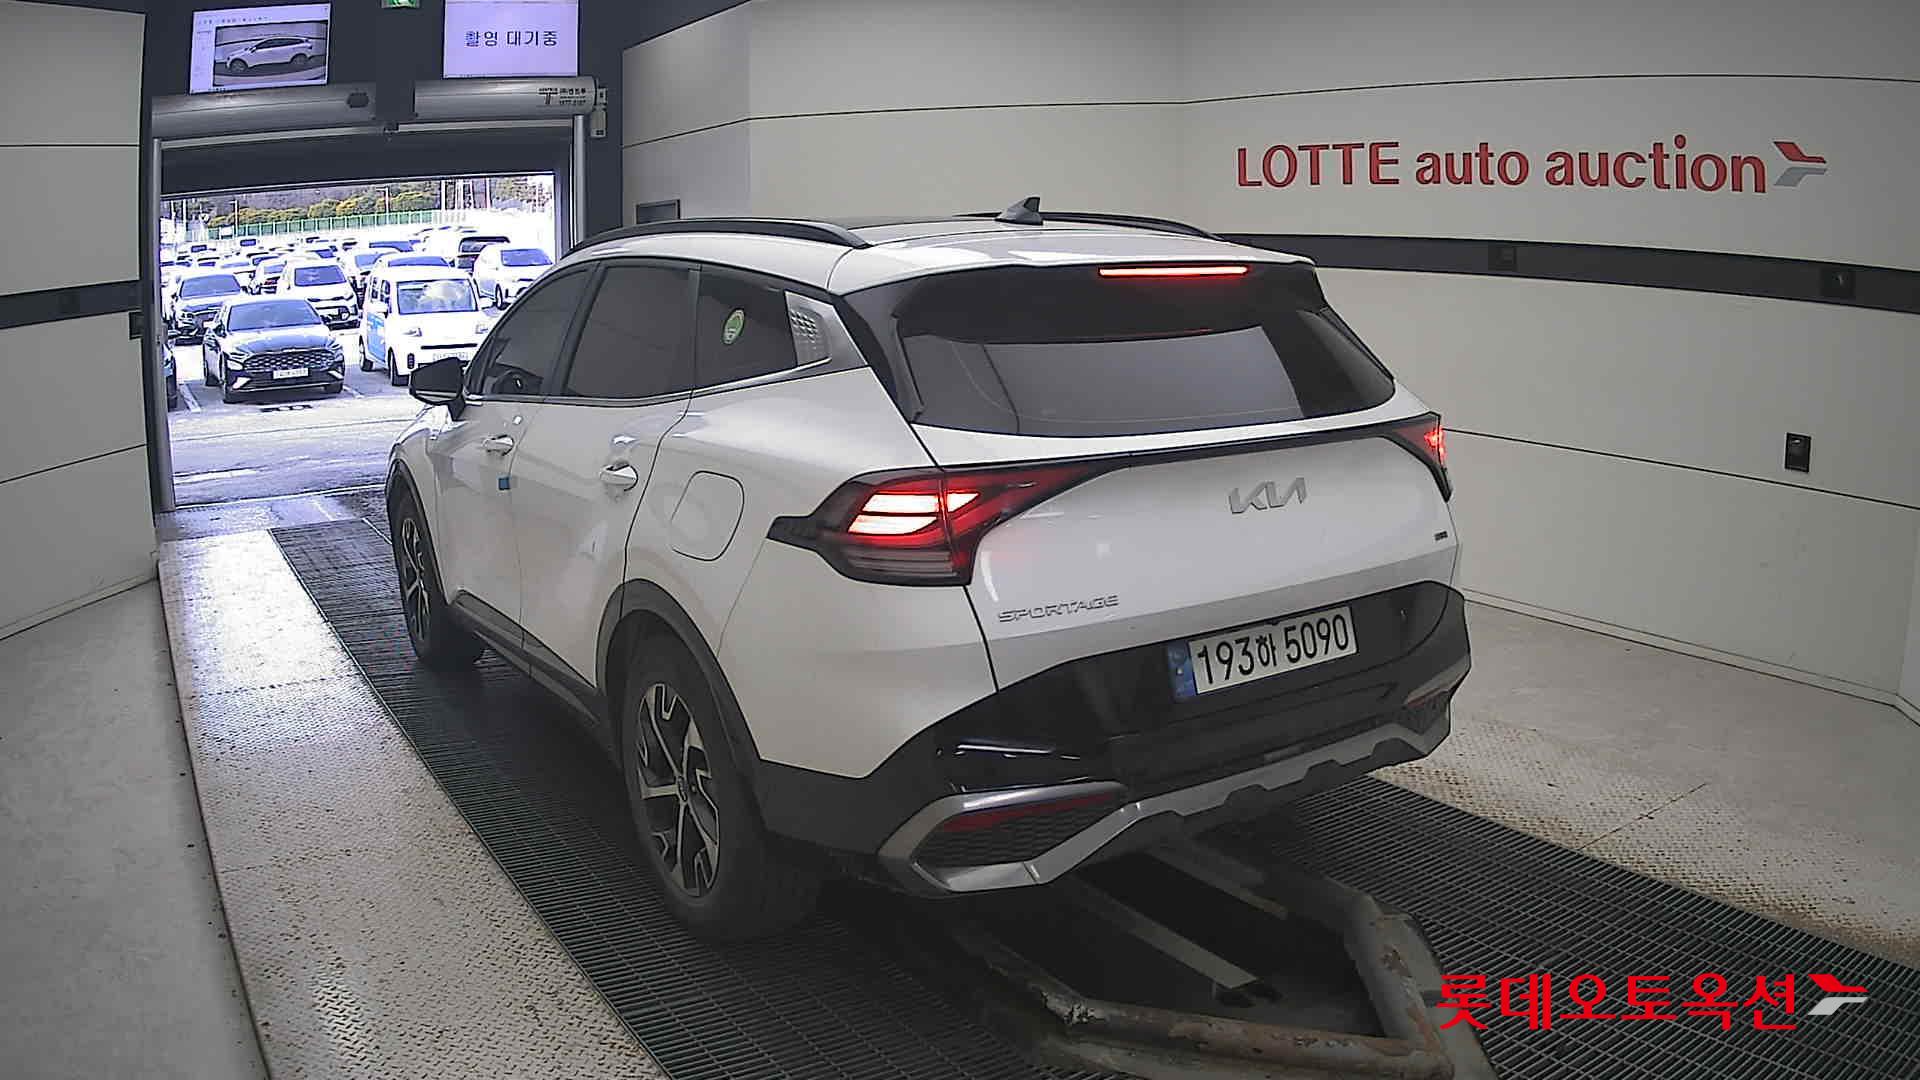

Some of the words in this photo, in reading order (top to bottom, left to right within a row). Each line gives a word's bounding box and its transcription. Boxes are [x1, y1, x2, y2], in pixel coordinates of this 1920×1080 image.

[506, 30, 557, 47] 대기중
[1237, 141, 1400, 187] LOTTE
[1415, 142, 1529, 186] auto
[1545, 134, 1767, 193] auction
[998, 595, 1119, 622] SPORTAGE
[1197, 632, 1278, 684] 193하
[1283, 613, 1349, 664] 5090
